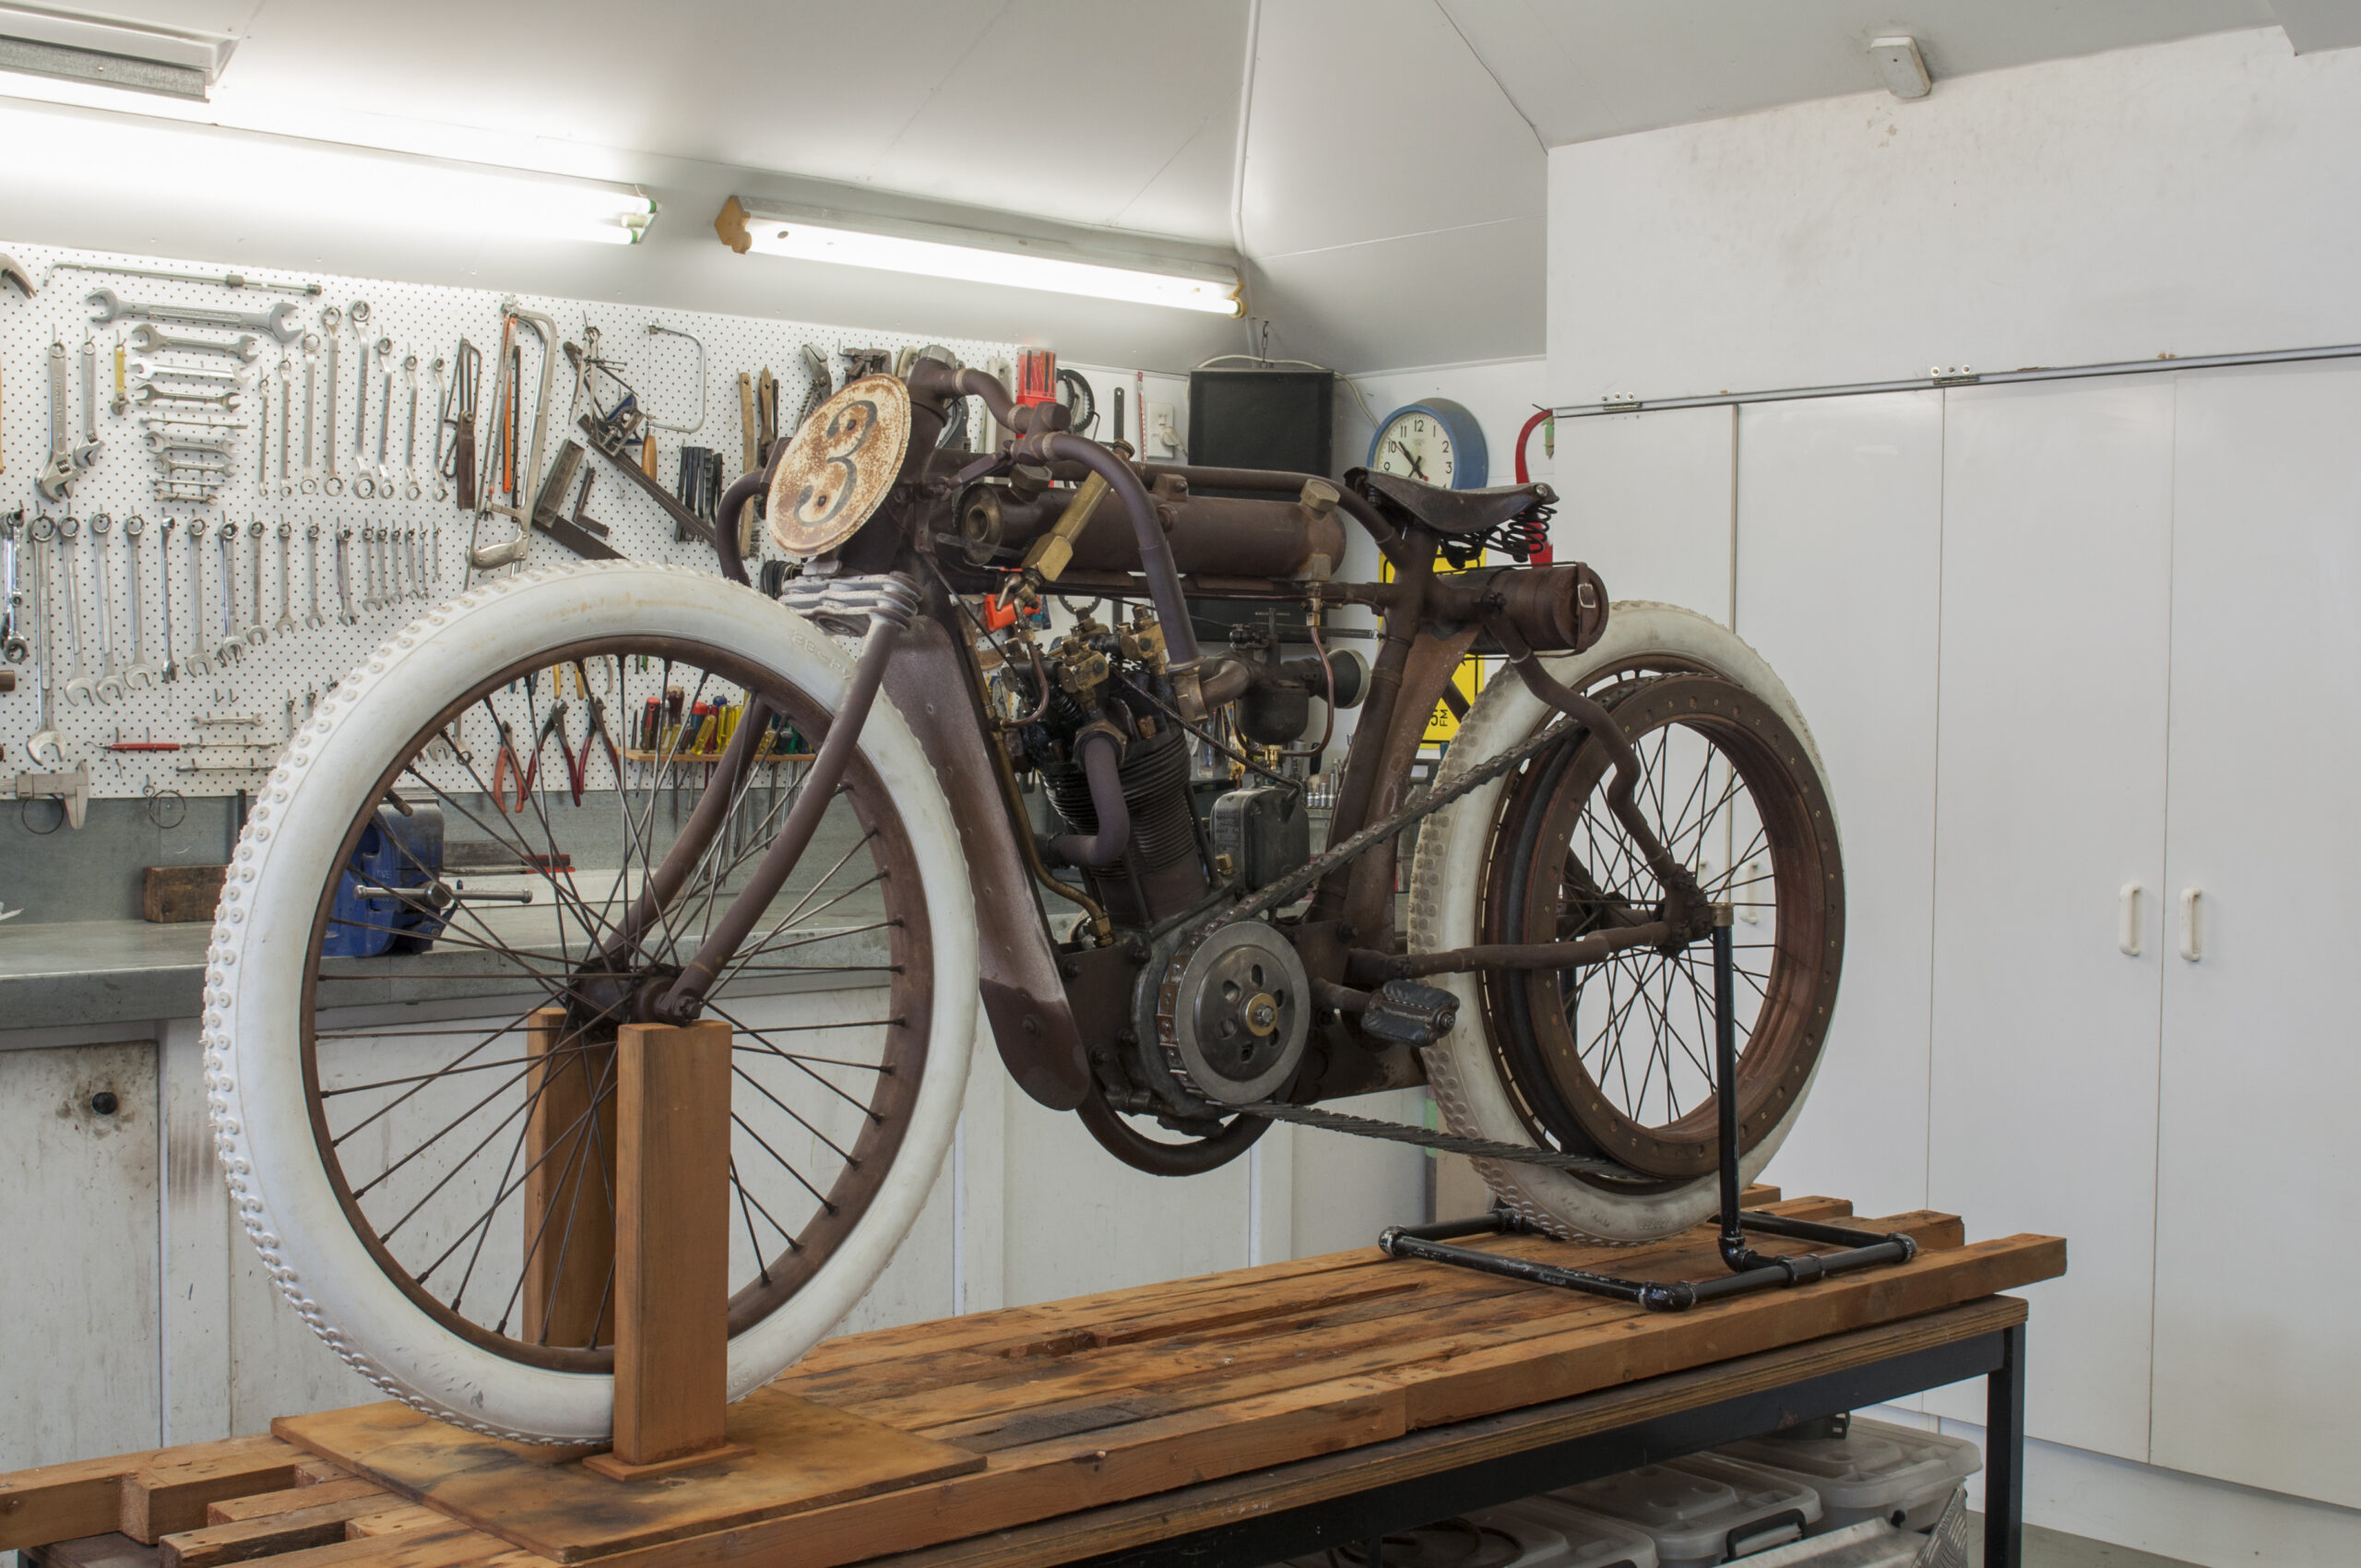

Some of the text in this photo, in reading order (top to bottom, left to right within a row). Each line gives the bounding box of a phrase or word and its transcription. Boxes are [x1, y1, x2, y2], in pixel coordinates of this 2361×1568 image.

[1400, 425, 1407, 438] 11
[1414, 420, 1424, 433] 12
[1388, 441, 1396, 453] 10
[1442, 440, 1449, 453] 2
[793, 399, 878, 529] 3
[1383, 461, 1391, 471] 9
[1445, 461, 1453, 474] 3
[1439, 708, 1449, 727] FM
